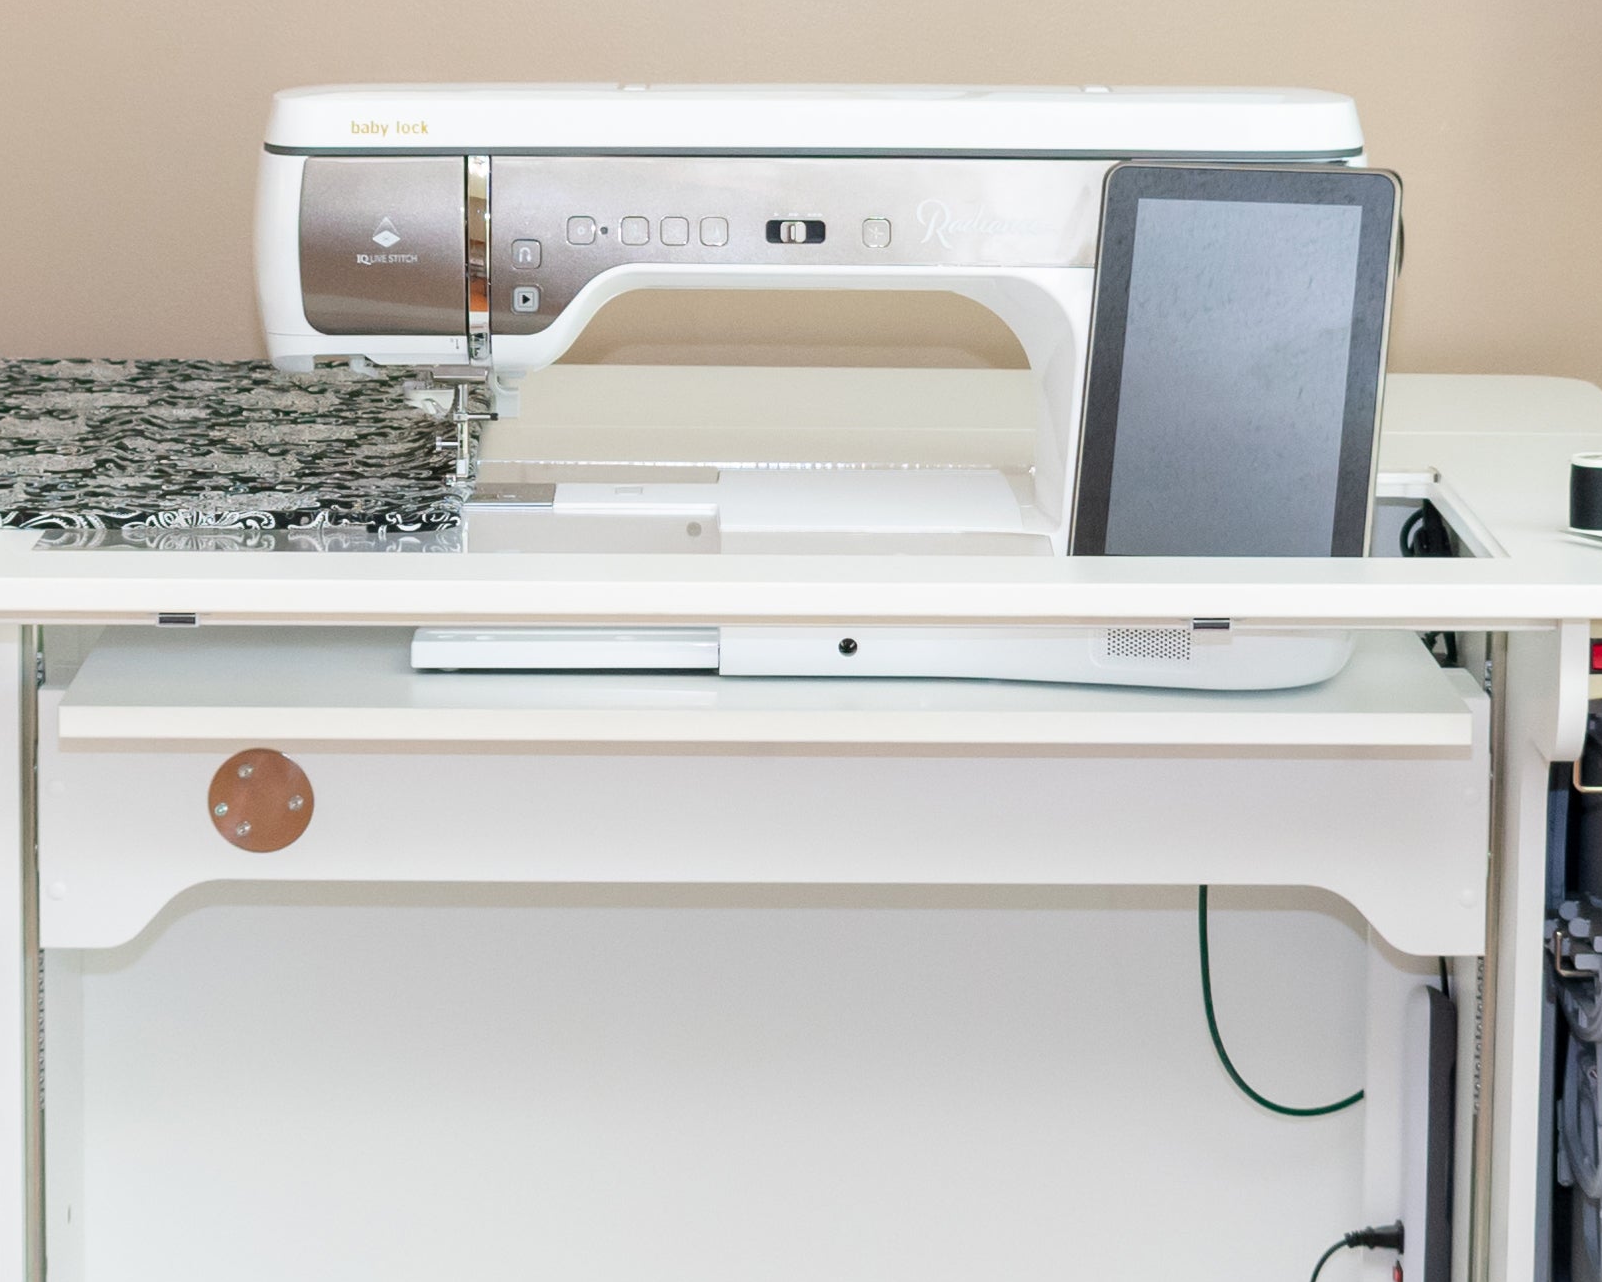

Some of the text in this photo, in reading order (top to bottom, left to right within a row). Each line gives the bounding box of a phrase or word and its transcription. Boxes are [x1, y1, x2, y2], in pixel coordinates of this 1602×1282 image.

[351, 120, 429, 137] baby lock
[356, 253, 372, 266] IQ
[388, 254, 418, 264] STITCH
